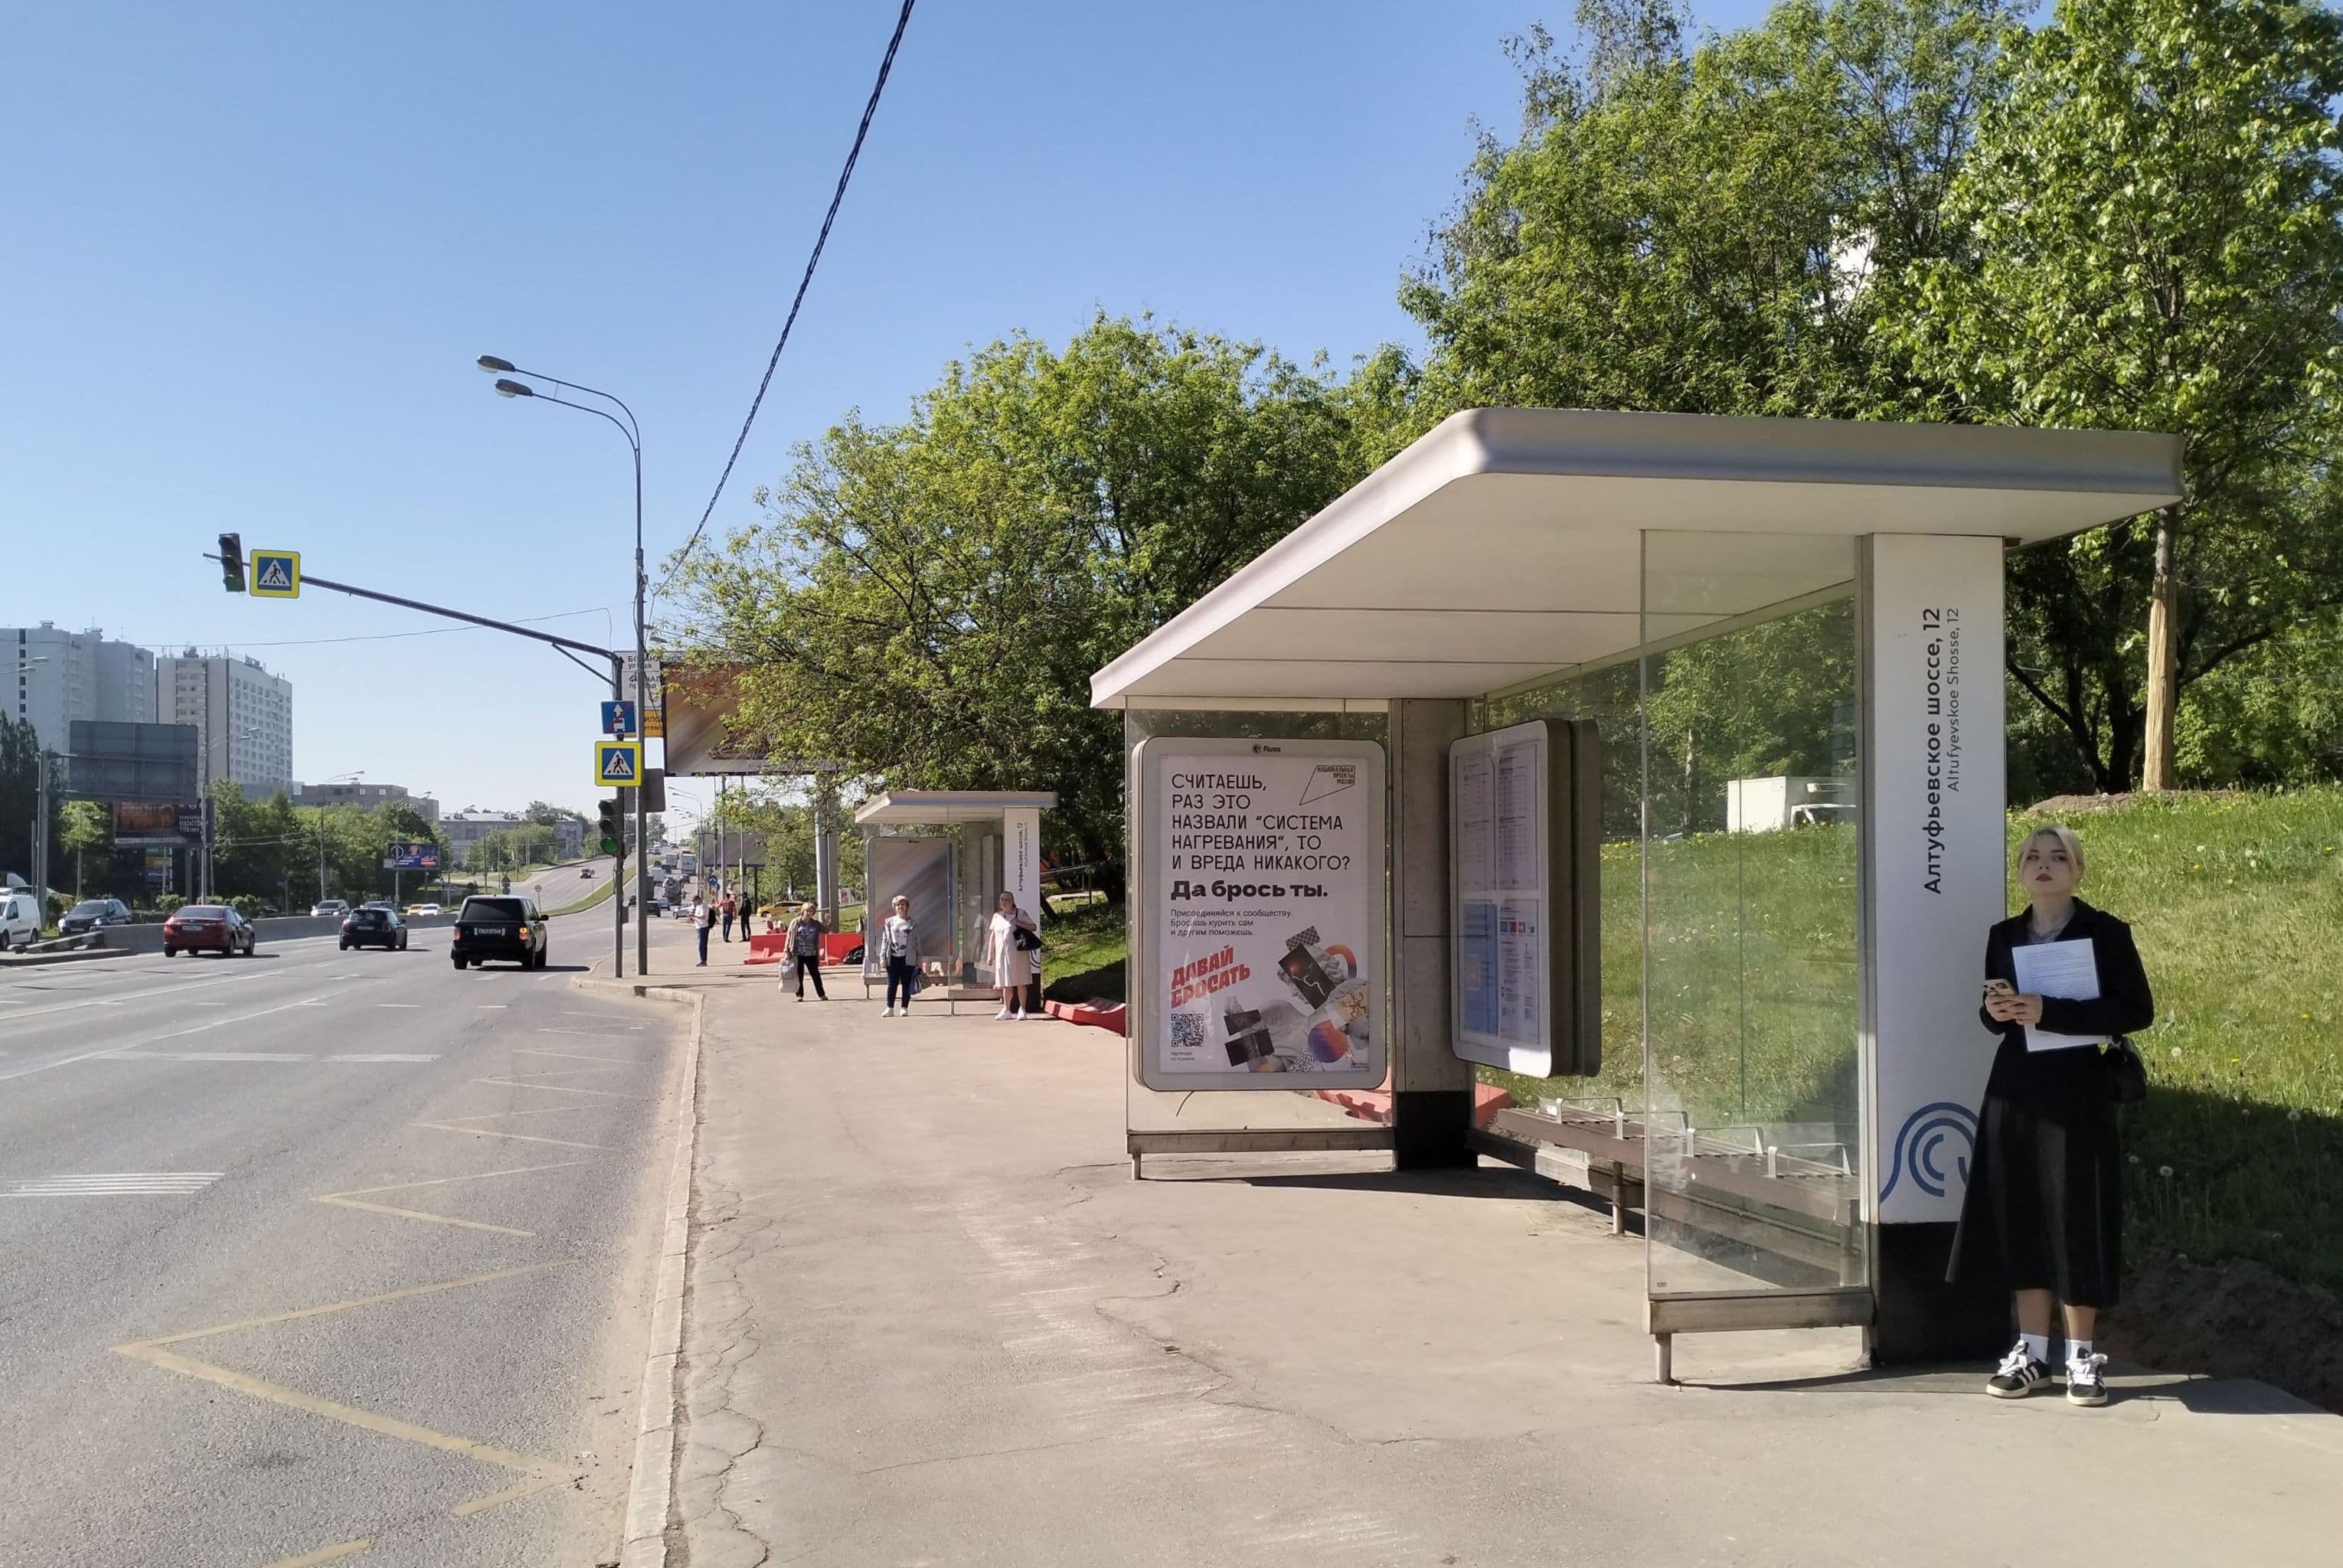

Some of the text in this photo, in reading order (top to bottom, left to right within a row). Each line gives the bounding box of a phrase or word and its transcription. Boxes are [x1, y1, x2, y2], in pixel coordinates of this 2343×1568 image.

[1946, 608, 1962, 792] Altufyevskoe Shosse, 12
[1922, 608, 1945, 895] Алтуфьевское шоссе, 12
[1172, 773, 1266, 792] СЧИТАЕШЬ,
[1172, 794, 1251, 810] РАЗ ЭТО
[1172, 814, 1247, 830] НАЗВАЛИ
[1296, 835, 1322, 851] ТО
[1172, 854, 1351, 873] И ВРЕДА НИКАКОГО?
[1170, 880, 1328, 903] Да брось ты.
[1170, 909, 1235, 919] Присоединяйся
[1177, 929, 1207, 938] другим
[1208, 920, 1237, 929] курить
[1171, 944, 1234, 990] ДАВАЙ
[1171, 963, 1250, 1009] БРОСАТЬ
